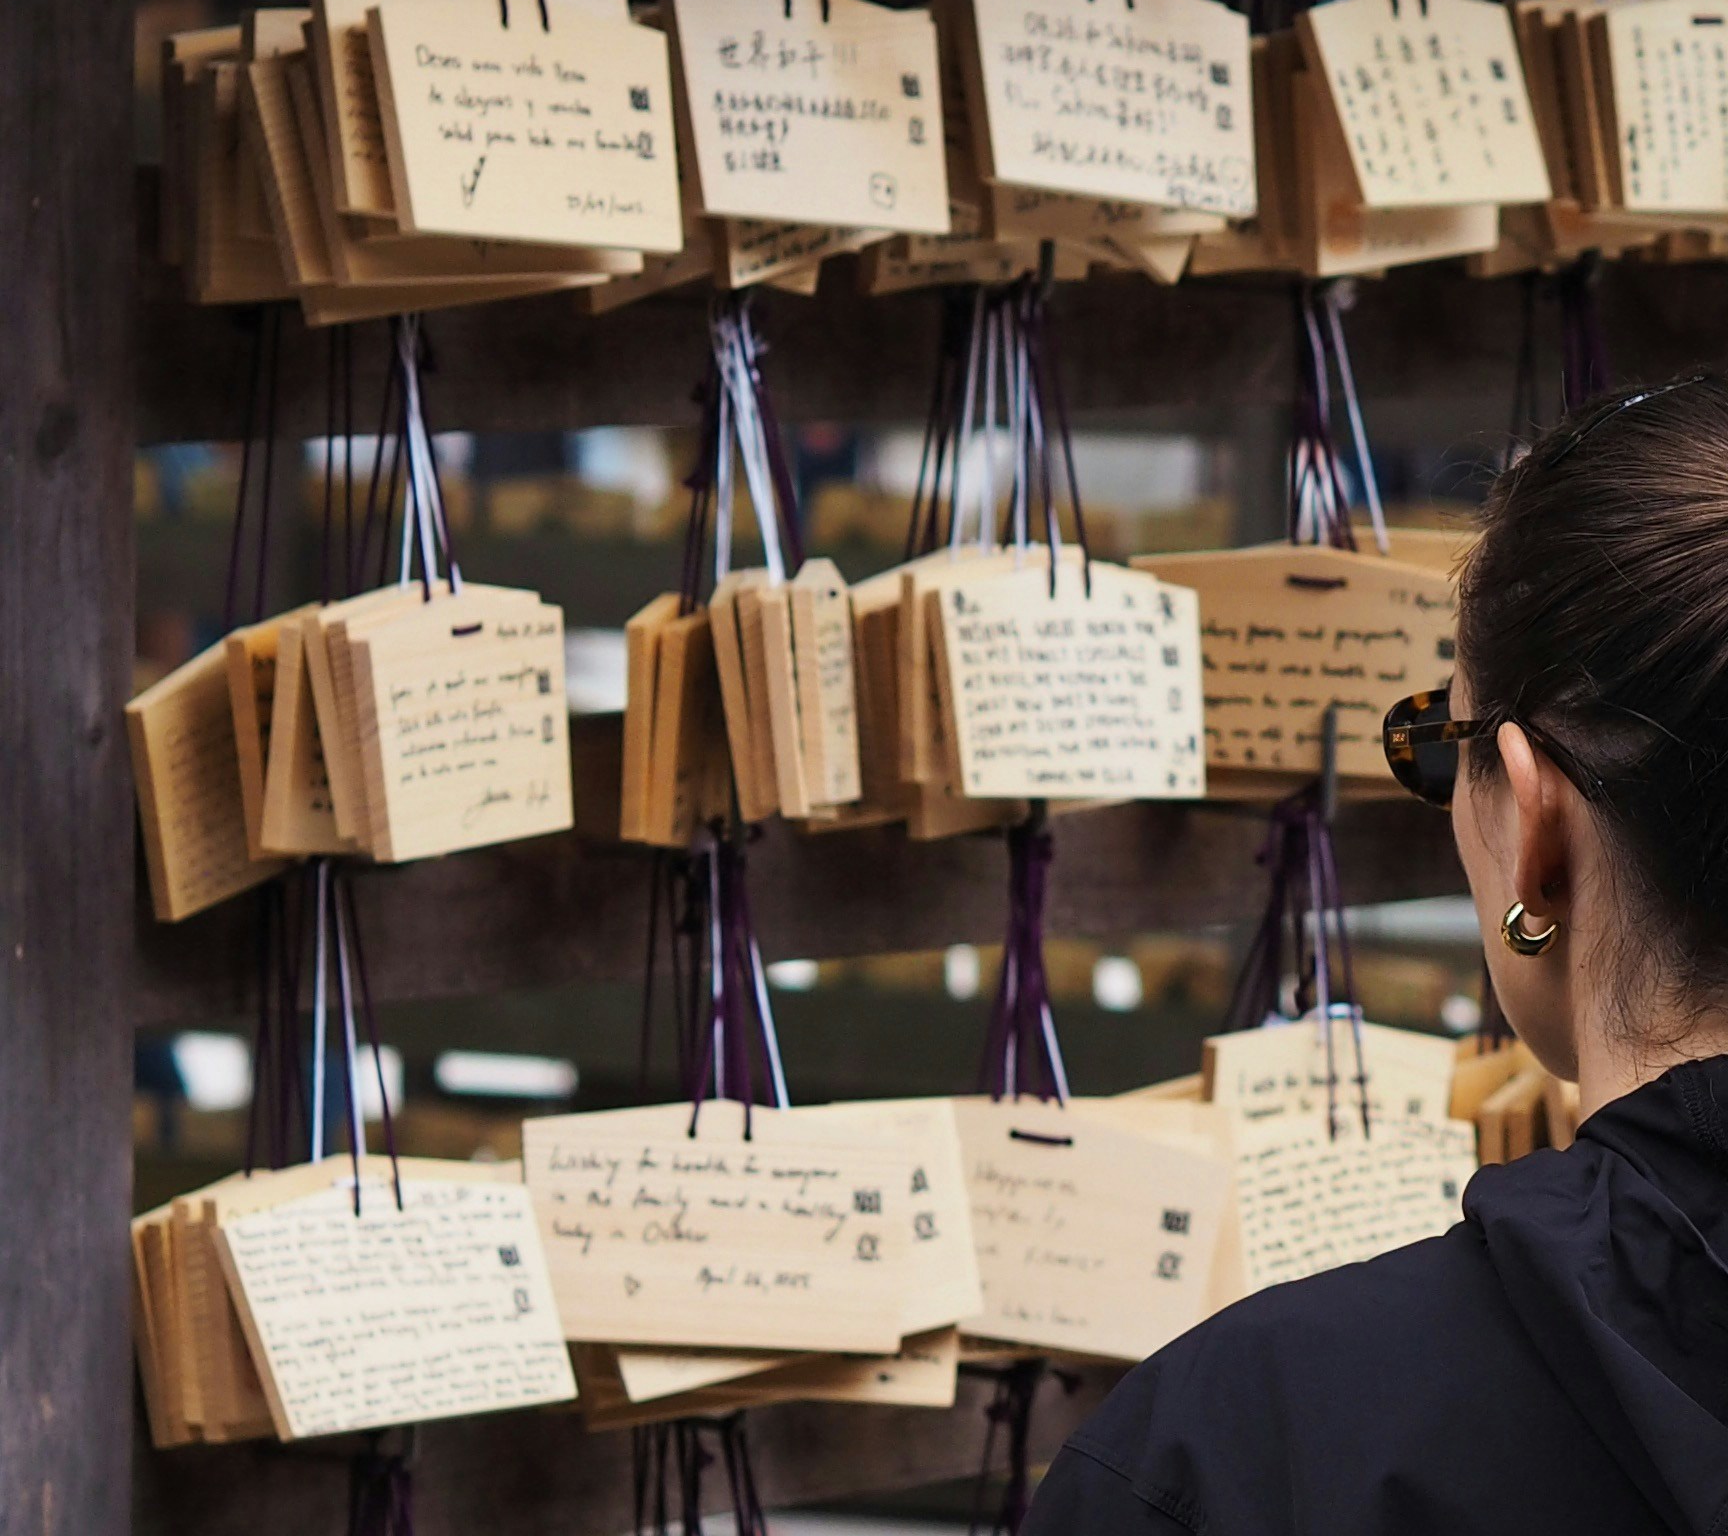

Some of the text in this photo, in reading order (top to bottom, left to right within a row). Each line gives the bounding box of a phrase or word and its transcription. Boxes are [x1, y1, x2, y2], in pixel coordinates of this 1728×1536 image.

[671, 1152, 732, 1175] health
[586, 1190, 613, 1208] the
[632, 1187, 690, 1230] family
